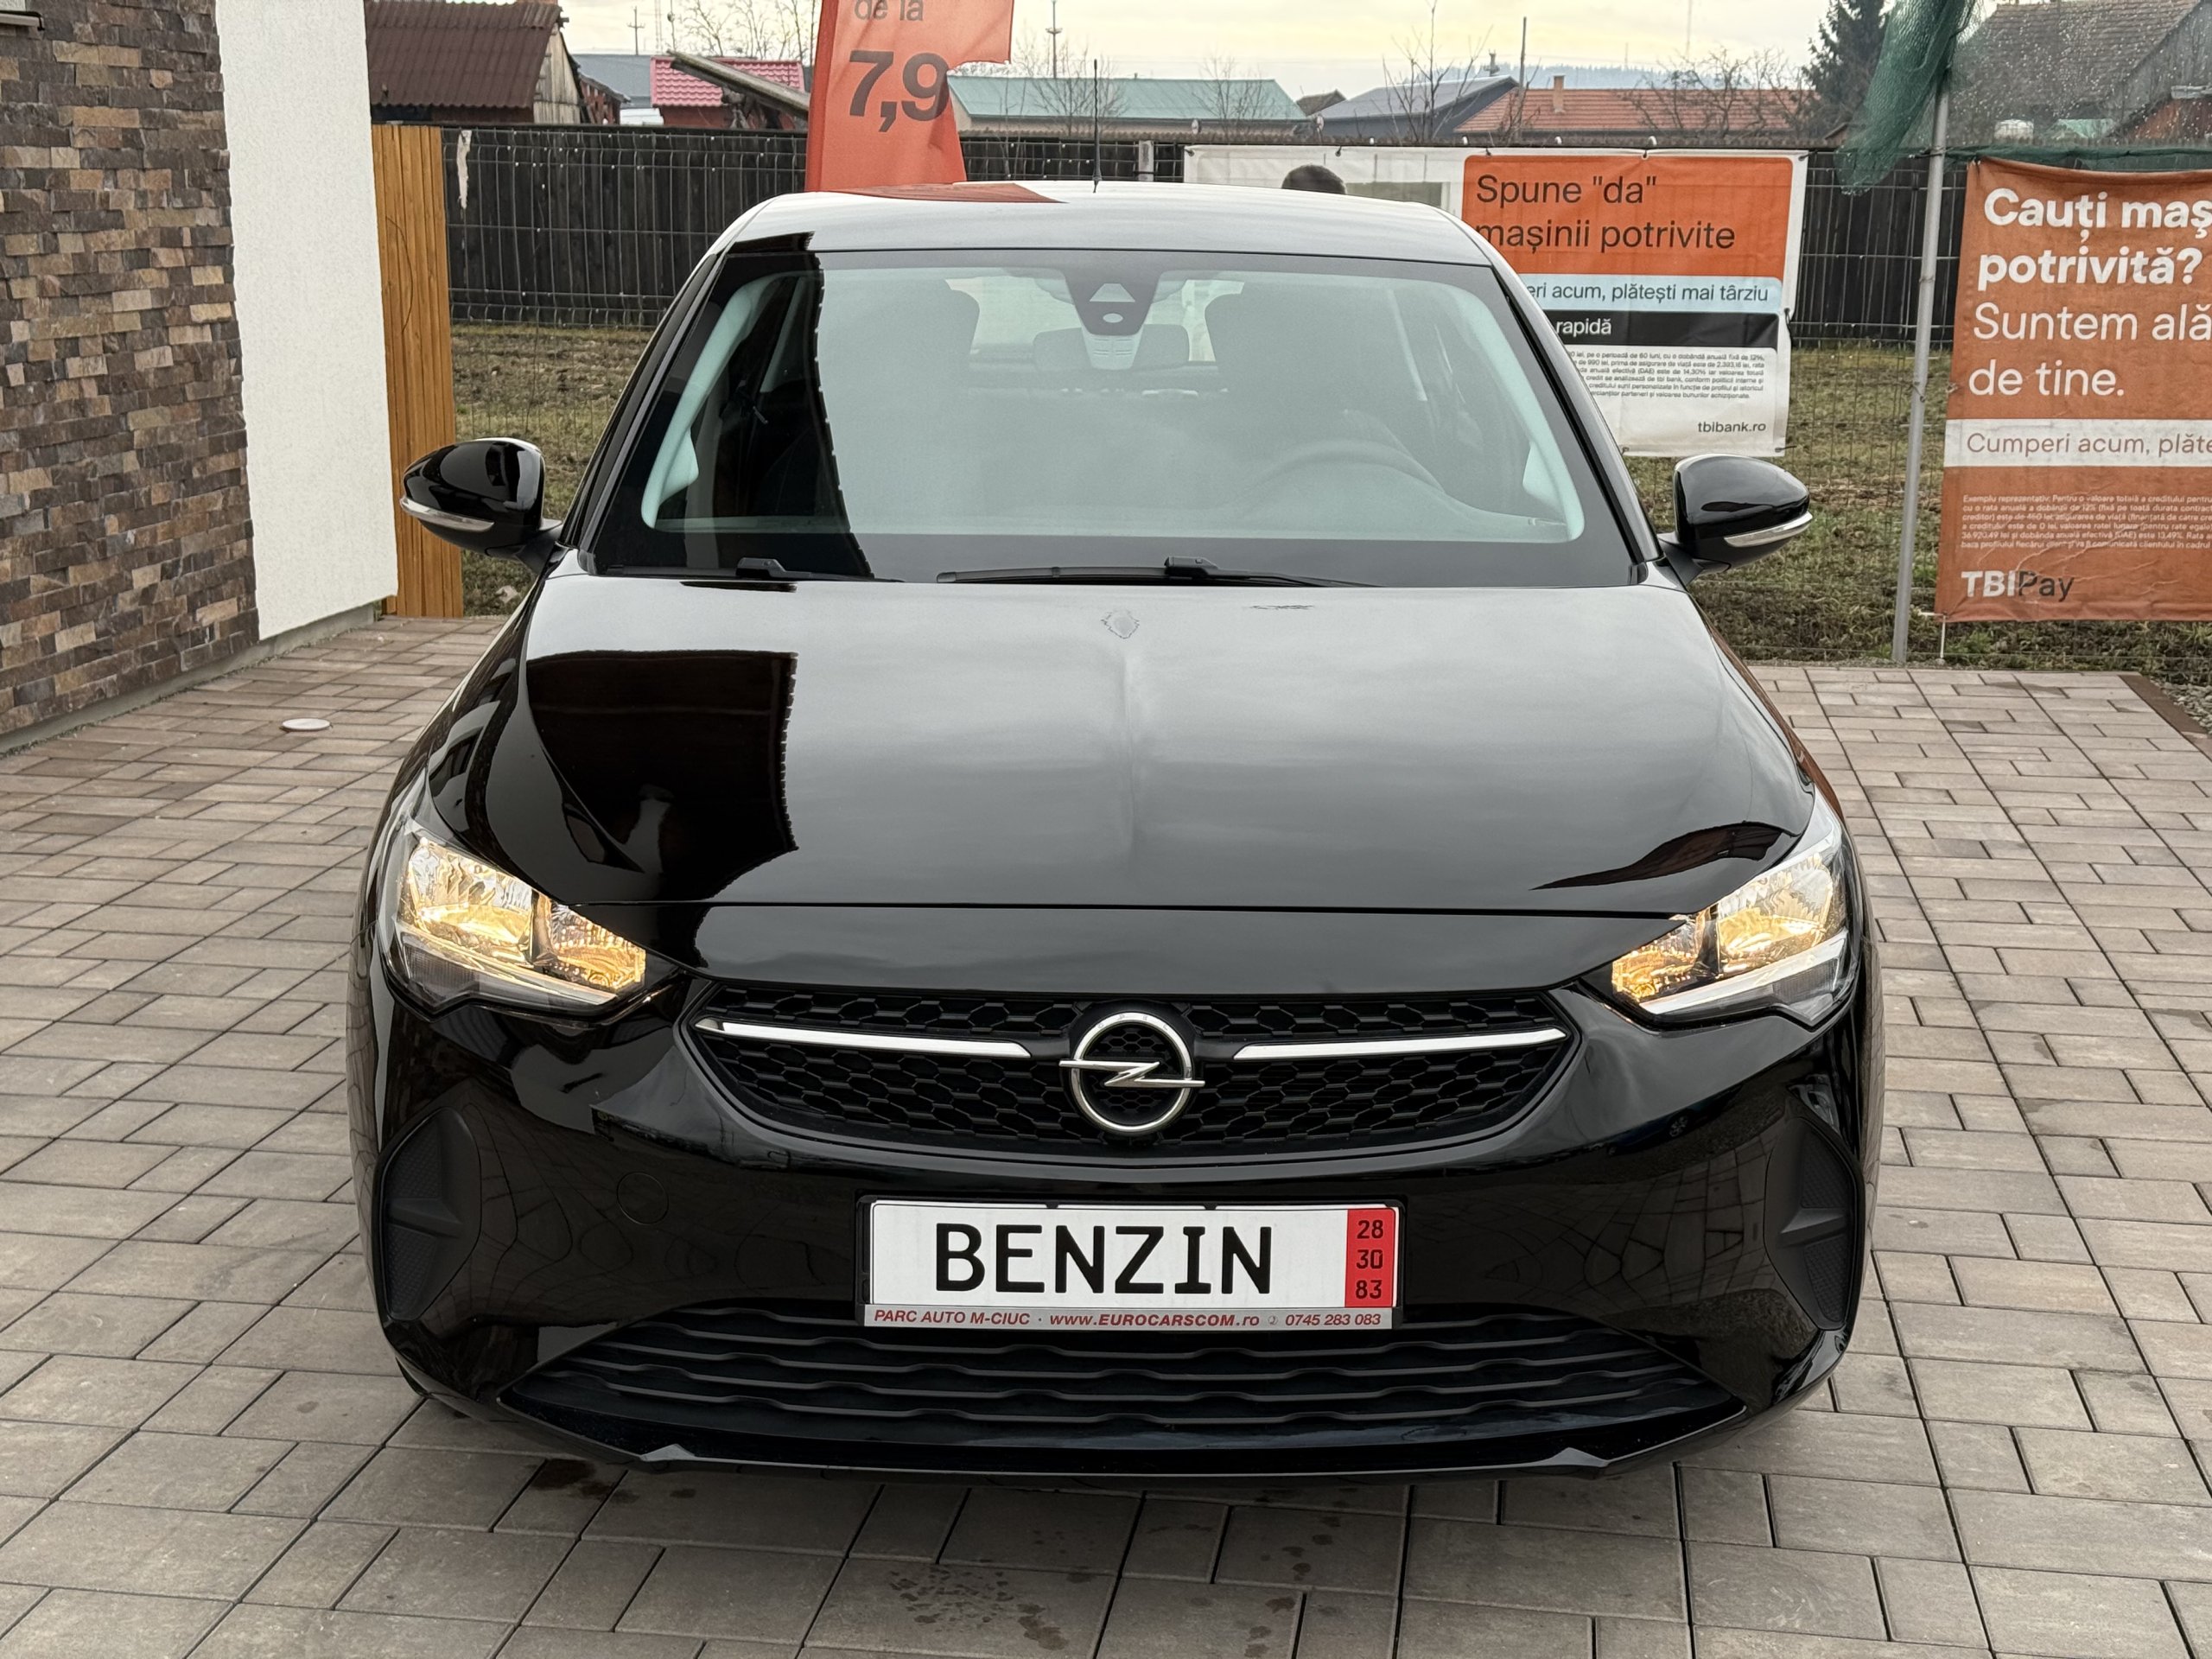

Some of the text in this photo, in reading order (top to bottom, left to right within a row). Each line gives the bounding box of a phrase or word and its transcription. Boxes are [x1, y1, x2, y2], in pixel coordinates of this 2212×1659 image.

[854, 0, 924, 22] de la
[849, 49, 950, 133] 7,9
[1477, 175, 1656, 209] Spune "da"
[1984, 188, 2107, 244] Cauți
[1600, 220, 1736, 253] potrivite
[1978, 245, 2203, 291] potrivită?
[1552, 284, 1606, 302] acum,
[1611, 283, 1676, 303] plătești
[1681, 283, 1714, 302] mai
[1719, 285, 1769, 302] târziu
[1556, 318, 1611, 338] rapidă
[1974, 302, 2138, 340] Suntem
[1968, 359, 2126, 397] de tine.
[1967, 433, 2070, 458] Cumperi
[2078, 436, 2151, 456] acum,
[1961, 569, 2075, 602] TBIPay
[1357, 1219, 1383, 1239] 28
[936, 1223, 1272, 1294] BENZIN
[1356, 1249, 1383, 1269] 30
[1355, 1280, 1382, 1300] 83
[874, 1310, 1382, 1326] PARC AUTO M-CIUC www.EUROCARSCOM.ro 0745 283 083
